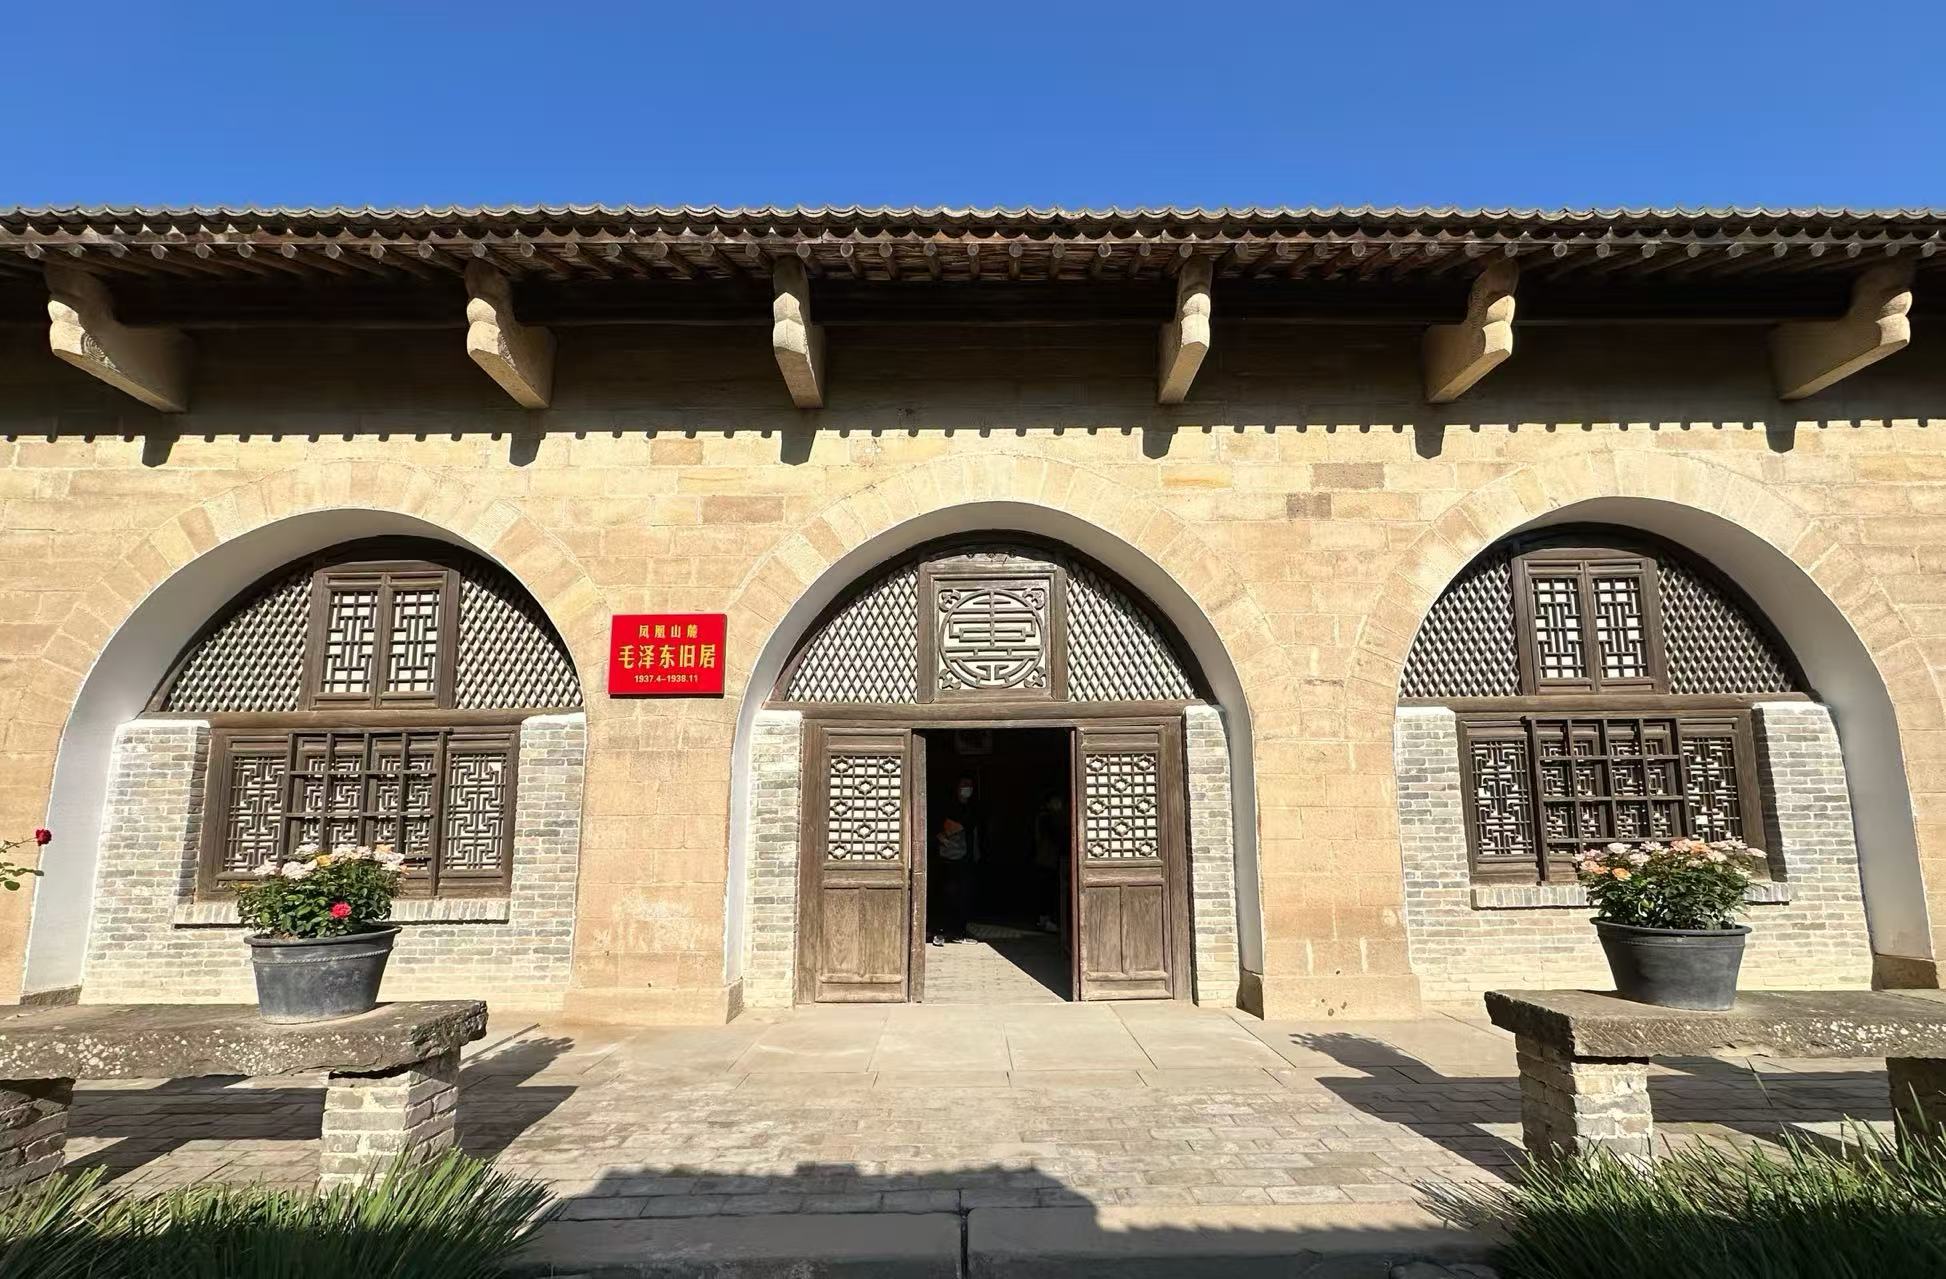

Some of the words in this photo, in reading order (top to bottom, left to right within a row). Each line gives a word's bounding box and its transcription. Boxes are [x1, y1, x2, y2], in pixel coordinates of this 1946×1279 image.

[618, 644, 716, 669] 毛泽东旧居
